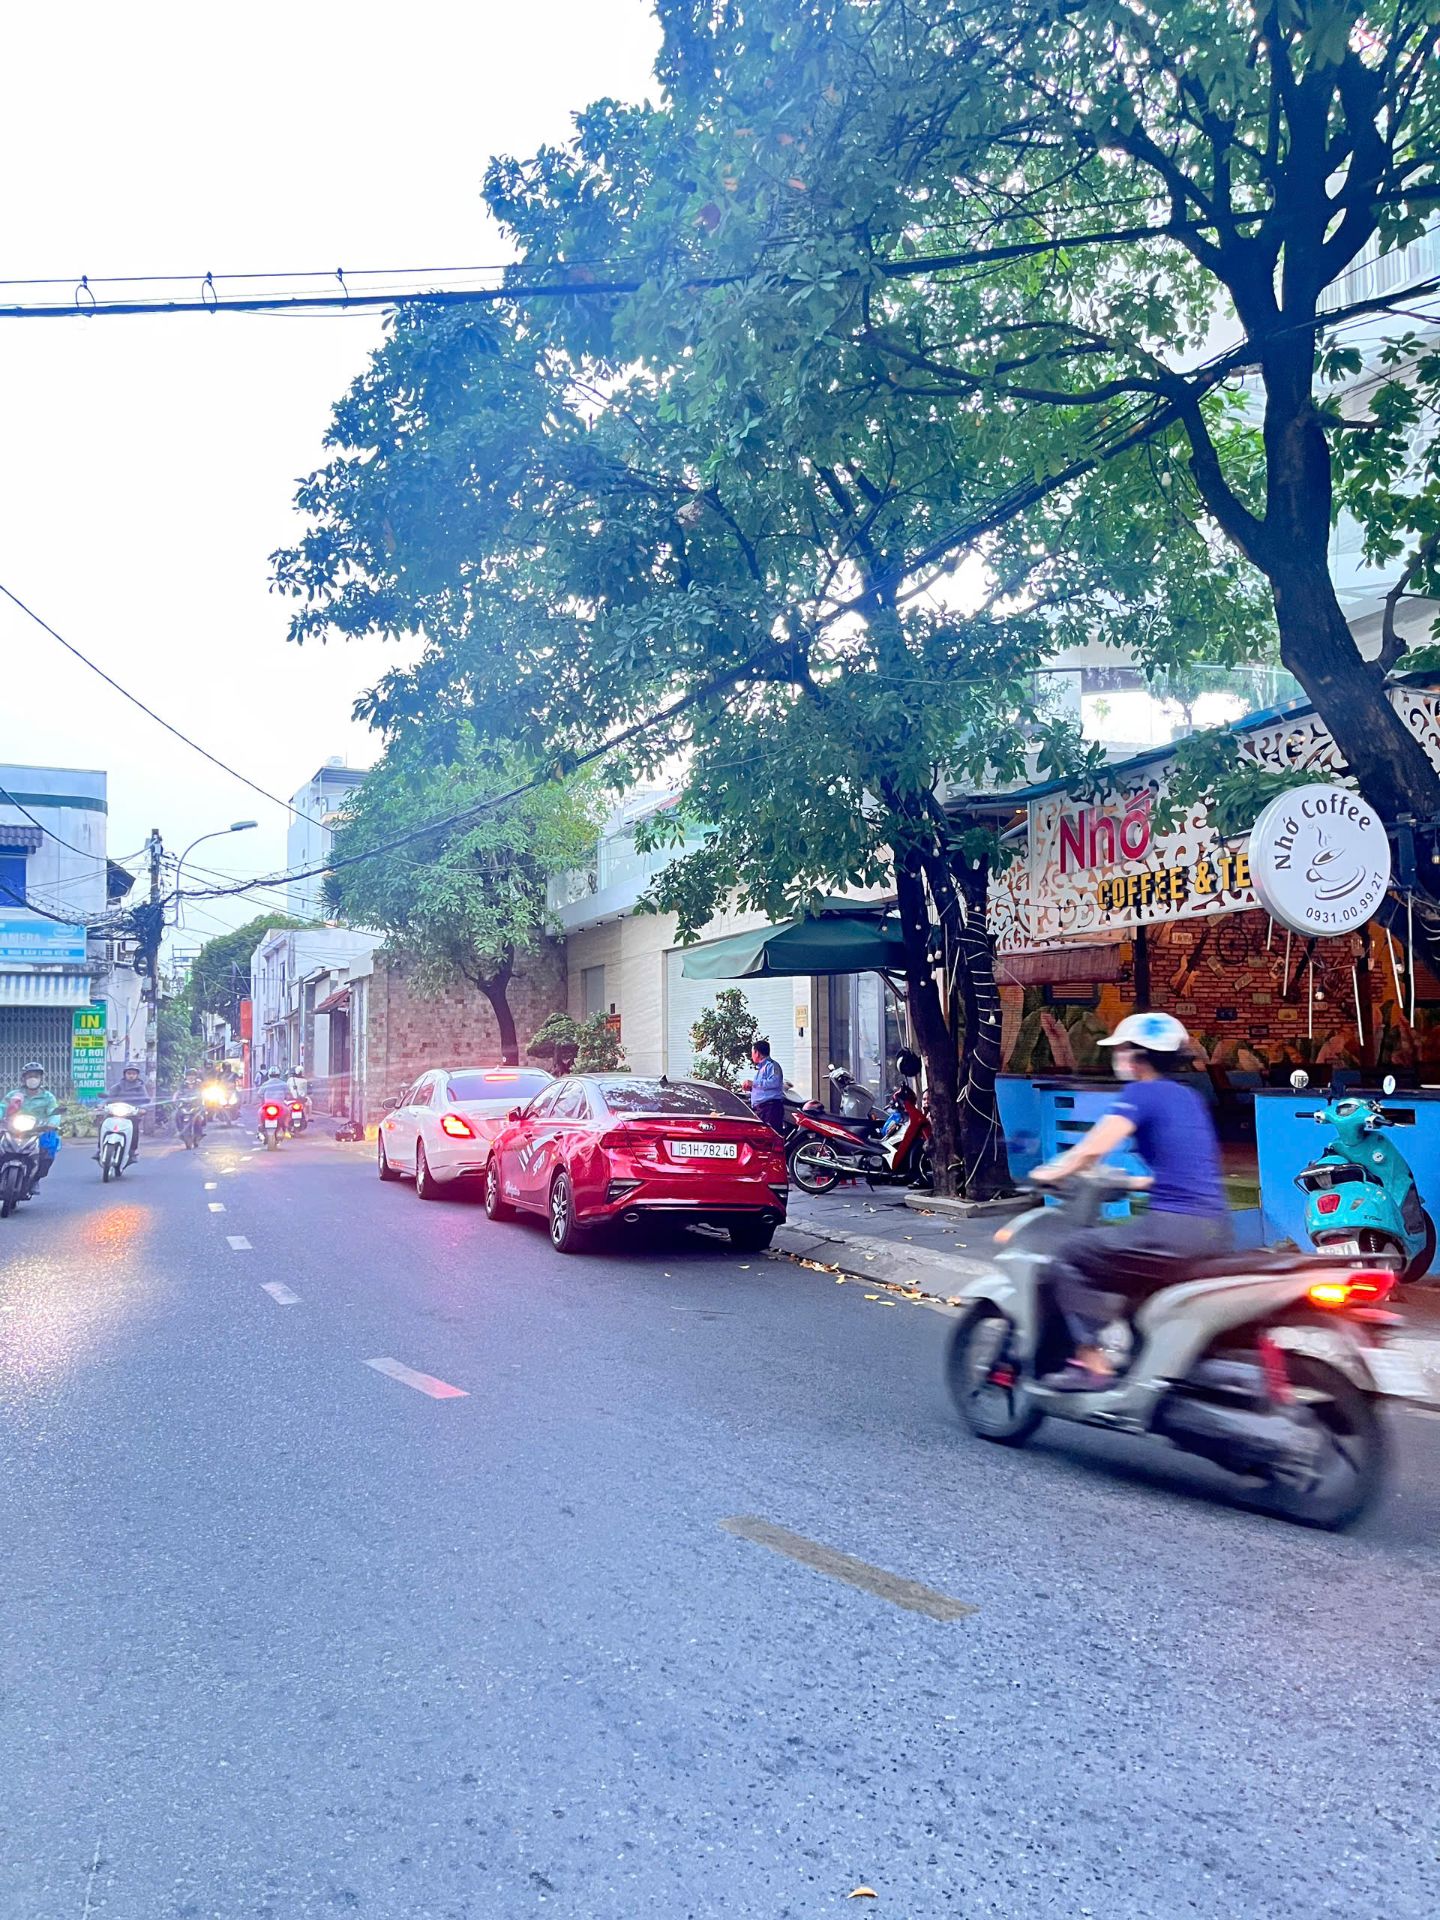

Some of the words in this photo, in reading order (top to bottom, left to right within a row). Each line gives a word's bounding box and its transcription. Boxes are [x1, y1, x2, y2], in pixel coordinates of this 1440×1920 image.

[1301, 793, 1371, 831] Coffee
[1097, 866, 1185, 911] COFFEE
[1194, 861, 1212, 894] &
[1306, 871, 1384, 923] 0931.00.99.27
[81, 1014, 100, 1028] IN
